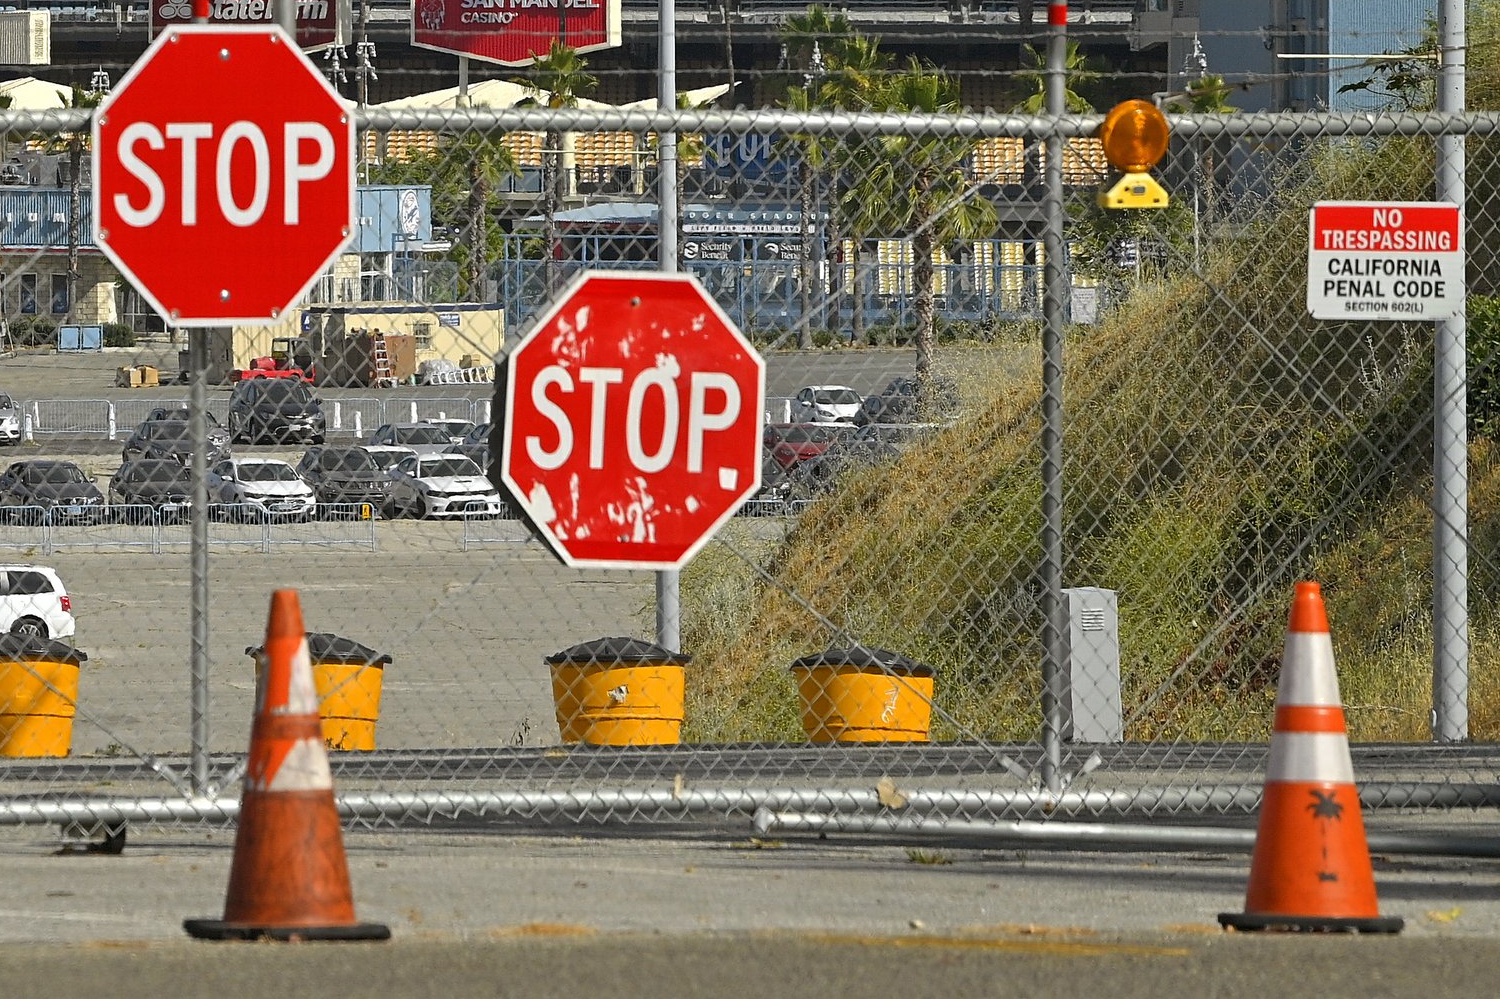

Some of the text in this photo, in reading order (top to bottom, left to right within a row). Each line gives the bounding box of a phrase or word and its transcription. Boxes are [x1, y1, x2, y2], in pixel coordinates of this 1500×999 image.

[460, 11, 513, 24] CASINO
[113, 120, 336, 227] STOP
[1373, 209, 1403, 228] NO
[701, 242, 733, 253] Security
[1322, 230, 1451, 250] TRESPASSING
[1328, 258, 1442, 277] CALIFORNIA
[1324, 280, 1446, 299] PENAL CODE
[1344, 301, 1424, 313] SECTION 602(L)
[525, 364, 741, 474] STOP
